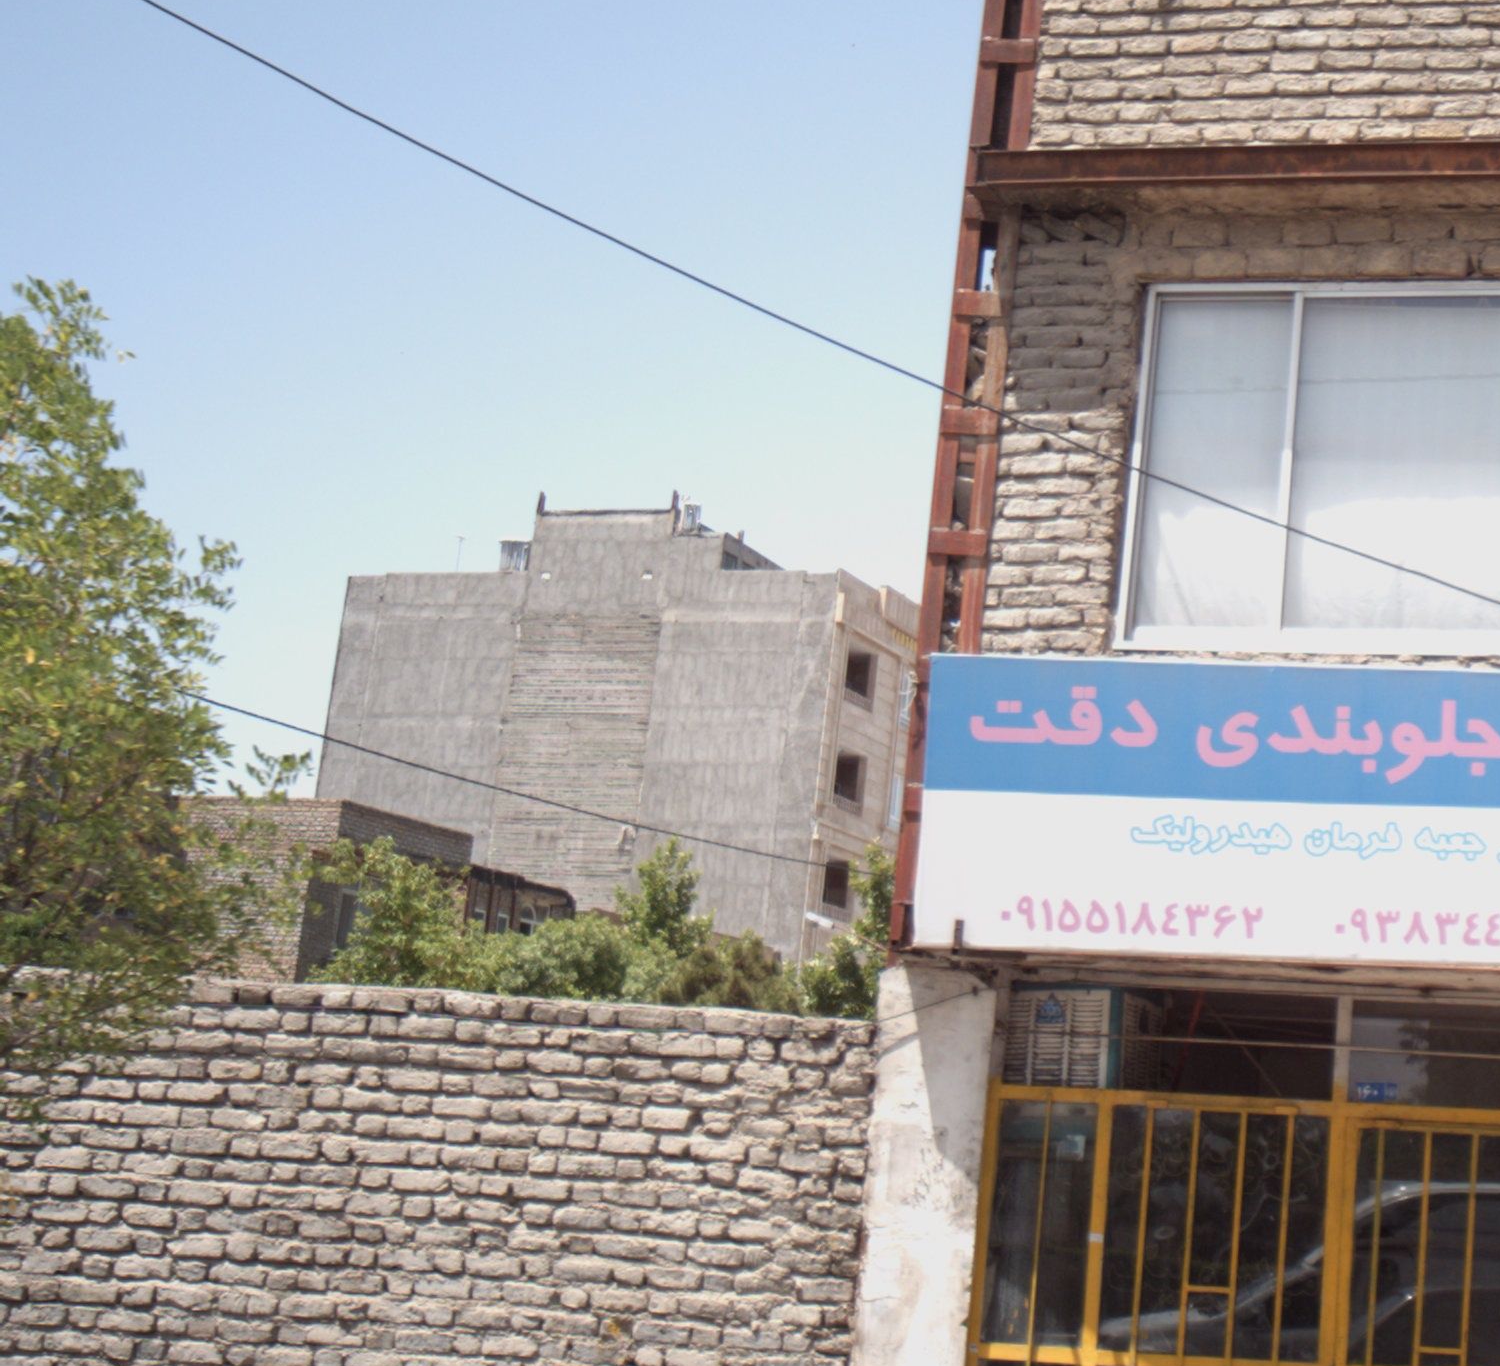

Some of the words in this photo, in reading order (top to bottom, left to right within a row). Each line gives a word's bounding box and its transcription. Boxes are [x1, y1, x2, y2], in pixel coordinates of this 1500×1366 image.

[970, 685, 1159, 748] دقت
[1130, 814, 1292, 855] هیدرولیک
[1304, 821, 1403, 859] فرمان
[1415, 826, 1487, 860] جعبه
